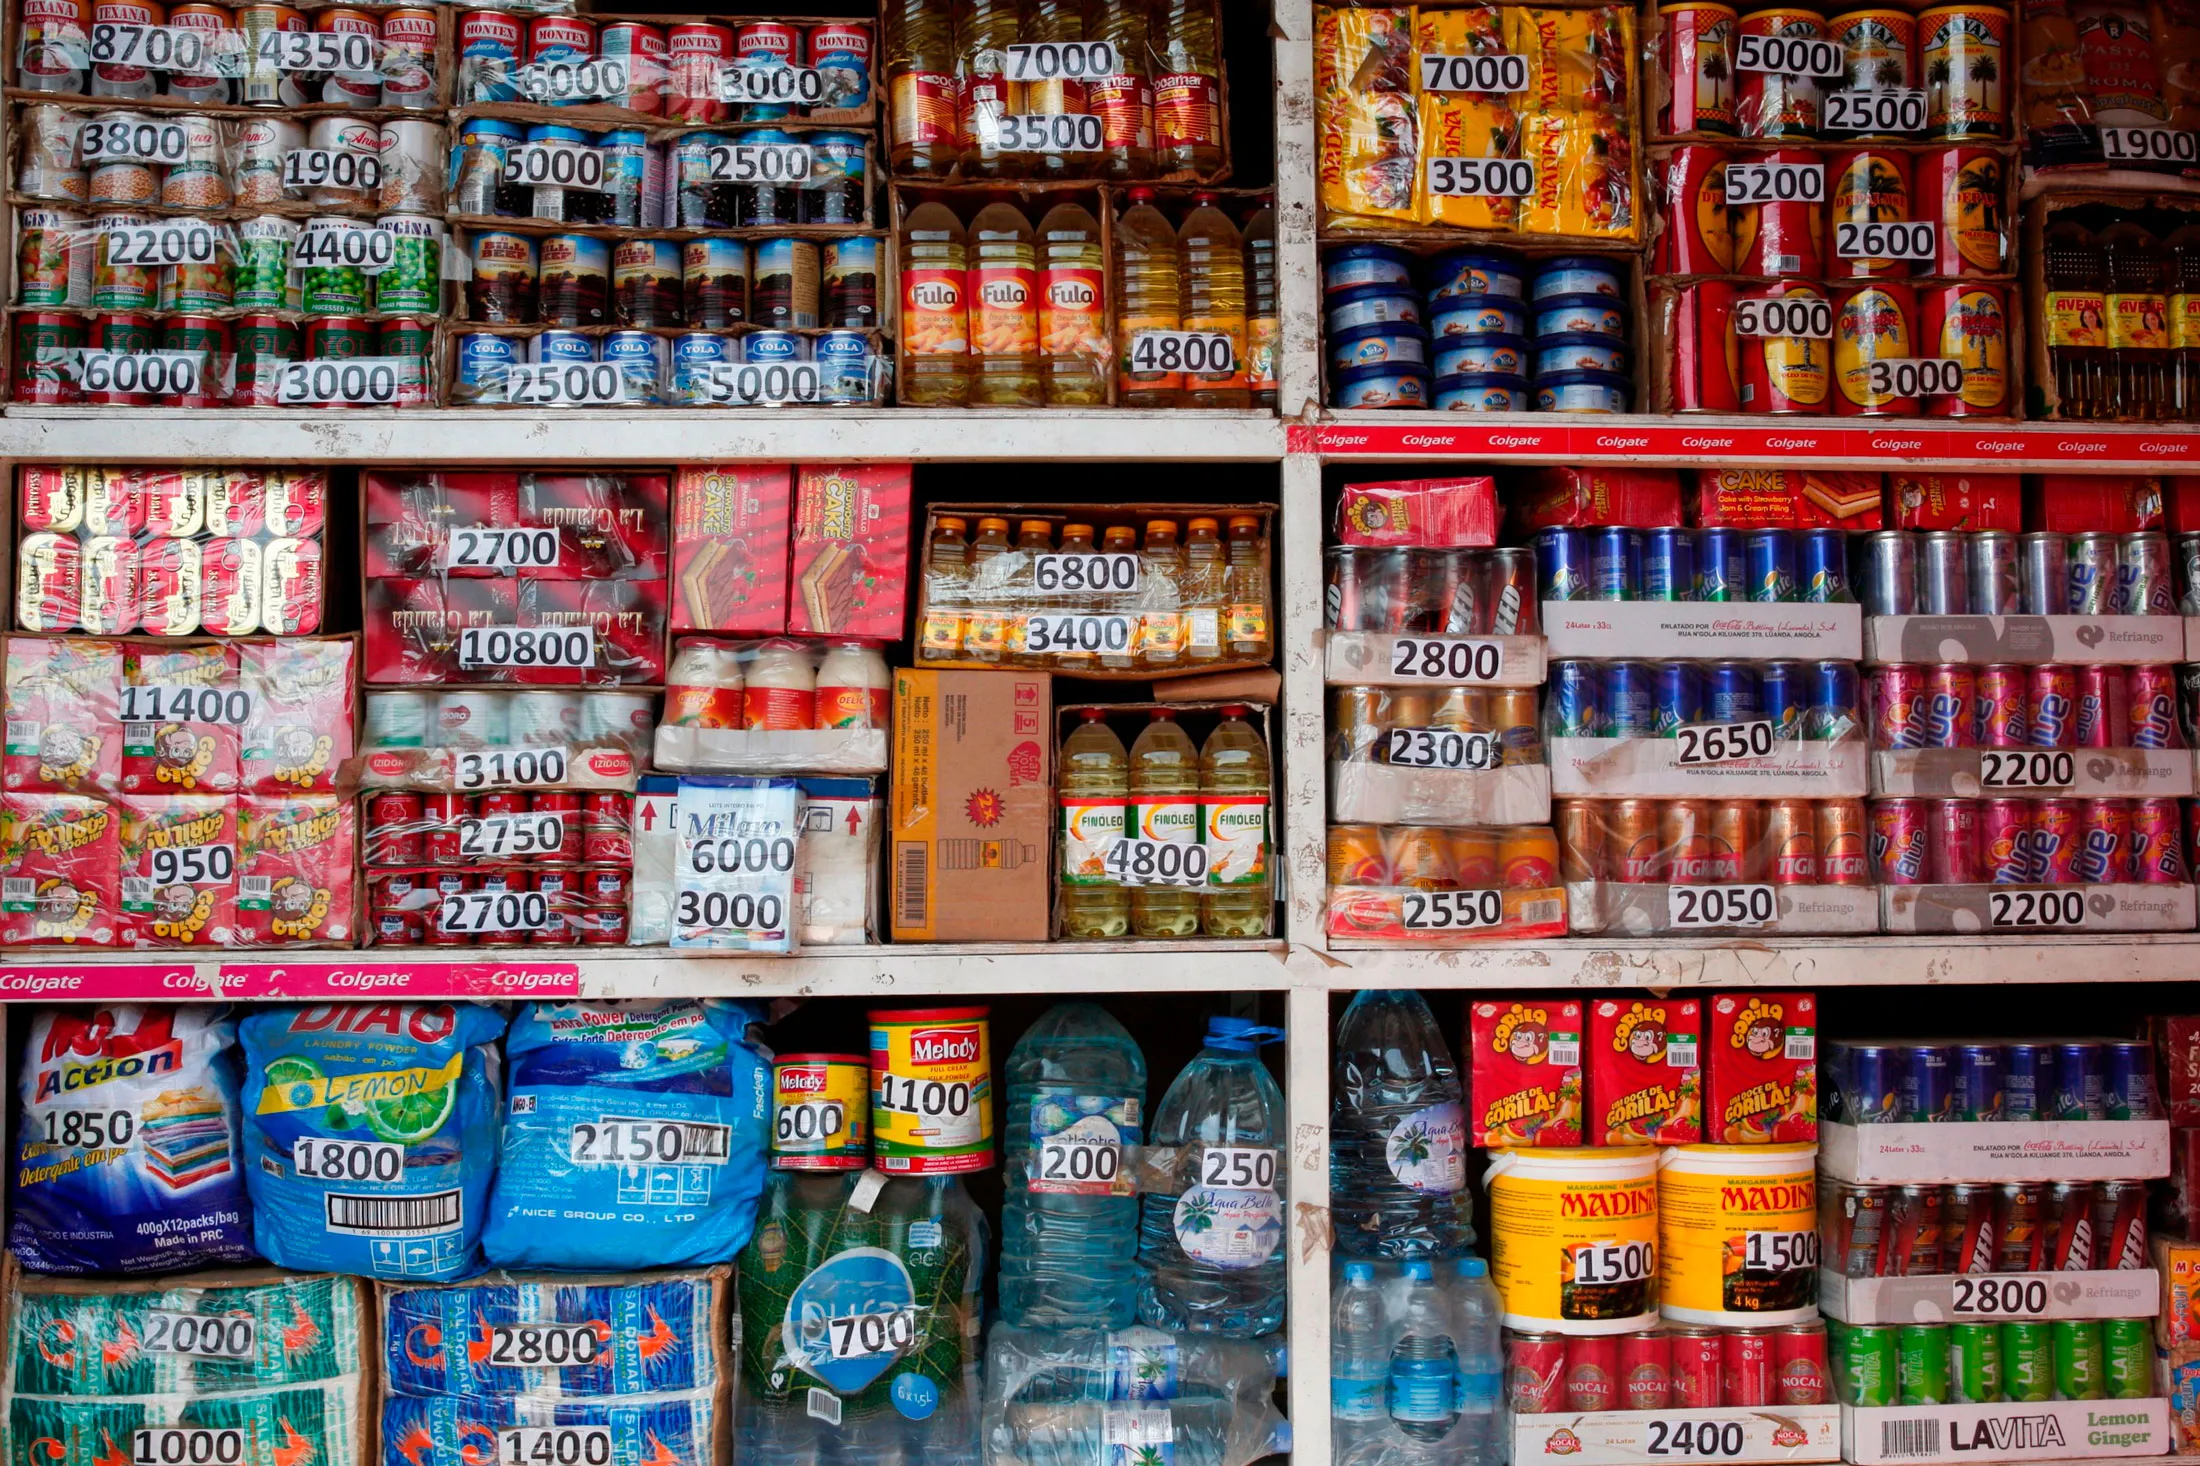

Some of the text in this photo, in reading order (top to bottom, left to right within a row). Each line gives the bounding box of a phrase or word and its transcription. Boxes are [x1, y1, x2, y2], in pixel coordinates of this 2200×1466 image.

[26, 1, 73, 16] TEXANA
[98, 7, 147, 22] TEXANA
[91, 27, 200, 68] 8700
[466, 24, 514, 38] MONTEX
[539, 29, 588, 43] MONTEX
[672, 37, 718, 49] MONTEX
[740, 36, 785, 47] MONTEX
[818, 36, 866, 48] MONTEX
[1936, 19, 1994, 46] HAYAT
[259, 32, 370, 70] 4350
[1009, 43, 1112, 78] 7000
[1739, 37, 1831, 74] 5000
[722, 69, 821, 100] 3000
[1424, 57, 1525, 89] 7000
[1828, 96, 1922, 128] 2500
[83, 124, 185, 158] 3800
[1000, 116, 1100, 149] 3500
[2105, 129, 2194, 159] 1900
[286, 152, 379, 187] 1900
[505, 149, 600, 183] 5000
[712, 147, 808, 180] 2500
[1434, 160, 1533, 194] 3500
[1540, 117, 1559, 210] MADINA
[1726, 167, 1822, 200] 5200
[110, 227, 211, 264] 2200
[300, 231, 392, 265] 4400
[482, 250, 528, 260] BEEF
[484, 241, 525, 251] BILL
[1839, 224, 1933, 256] 2600
[913, 285, 956, 305] Fula
[983, 284, 1025, 303] Fula
[1051, 285, 1093, 304] Fula
[2118, 301, 2165, 314] AVENA
[1738, 302, 1831, 336] 6000
[556, 342, 586, 354] YOLA
[613, 343, 644, 354] YOLA
[685, 344, 715, 356] YOLA
[758, 342, 788, 354] YOLA
[828, 342, 858, 354] YOLA
[1135, 336, 1229, 371] 4800
[86, 355, 194, 394] 6000
[286, 365, 395, 400] 3000
[512, 365, 618, 402] 2500
[713, 366, 817, 400] 5000
[1871, 361, 1962, 396] 3000
[1976, 441, 2024, 452] Colgate
[2058, 442, 2106, 453] Colgate
[2140, 442, 2188, 454] Colgate
[1719, 471, 1787, 491] CAKE
[702, 475, 723, 534] CAKE
[823, 479, 844, 538] CAKE
[1753, 495, 1792, 504] Strawberry
[1769, 505, 1790, 513] Filling
[619, 508, 644, 532] La
[457, 531, 556, 565] 2700
[1037, 556, 1135, 589] 6800
[464, 631, 588, 665] 10800
[1028, 617, 1127, 650] 3400
[2110, 632, 2163, 644] Refriango
[1395, 640, 1499, 679] 2800
[121, 687, 250, 722] 11400
[1392, 731, 1489, 767] 2300
[1679, 723, 1772, 763] 2650
[462, 751, 564, 787] 3100
[1010, 754, 1021, 787] heart
[1017, 750, 1030, 780] your
[1029, 755, 1039, 782] care
[1982, 754, 2073, 786] 2200
[30, 812, 108, 850] GORILA!
[146, 813, 225, 850] GORILA!
[462, 817, 561, 853] 2750
[1082, 813, 1123, 827] FINÓLEO
[154, 848, 232, 884] 950
[692, 838, 794, 872] 6000
[1107, 841, 1205, 878] 4800
[446, 894, 547, 930] 2700
[678, 891, 781, 929] 3000
[1406, 891, 1500, 928] 2550
[1678, 888, 1772, 923] 2050
[1798, 902, 1854, 915] Refriango
[1992, 892, 2084, 926] 2200
[2121, 900, 2173, 912] Refriango
[0, 974, 84, 993] Colgate
[327, 970, 411, 990] Colgate
[492, 970, 575, 989] Colgate
[552, 1007, 670, 1030] Extra Power Detergent
[607, 1016, 688, 1042] Detergente em
[304, 1039, 417, 1054] LAUNDRY POWDER
[914, 1037, 978, 1060] Melody
[39, 1050, 173, 1101] Action
[324, 1071, 427, 1104] LEMON
[780, 1072, 824, 1090] Melody
[1741, 1085, 1763, 1100] DOCE
[1765, 1081, 1778, 1091] DE
[753, 1066, 764, 1120] Fasclean
[881, 1075, 968, 1116] 1100
[1485, 1091, 1556, 1128] GORILA!
[1606, 1090, 1676, 1126] GORILA!
[1725, 1086, 1790, 1122] GORILA!
[44, 1110, 133, 1149] 1850
[778, 1106, 843, 1139] 600
[574, 1125, 682, 1161] 2150
[298, 1140, 400, 1180] 1800
[1045, 1145, 1117, 1179] 200
[1206, 1152, 1274, 1186] 250
[136, 1210, 239, 1236] 400gX12packs/bag
[523, 1208, 696, 1223] NICE GROUP LTD
[154, 1228, 224, 1249] Made in PRC
[1747, 1232, 1815, 1271] 1500
[1578, 1242, 1653, 1282] 1500
[1734, 1298, 1759, 1310] 4 kg
[1954, 1280, 2046, 1313] 2800
[2087, 1287, 2140, 1299] Refriango
[145, 1316, 252, 1353] 2000
[454, 1293, 472, 1394] SALDOMAR
[492, 1328, 597, 1364] 2800
[625, 1290, 639, 1391] SALDOMAR
[832, 1312, 913, 1355] 700
[1569, 1383, 1608, 1394] NOCAL
[1629, 1382, 1667, 1393] NOCAL
[1783, 1377, 1822, 1388] NOCAL
[1950, 1415, 2065, 1450] LAVITA
[2087, 1413, 2149, 1427] Lemon
[136, 1430, 241, 1463] 1000
[504, 1430, 609, 1465] 1400
[1648, 1422, 1743, 1455] 2400
[2087, 1432, 2151, 1447] Ginger
